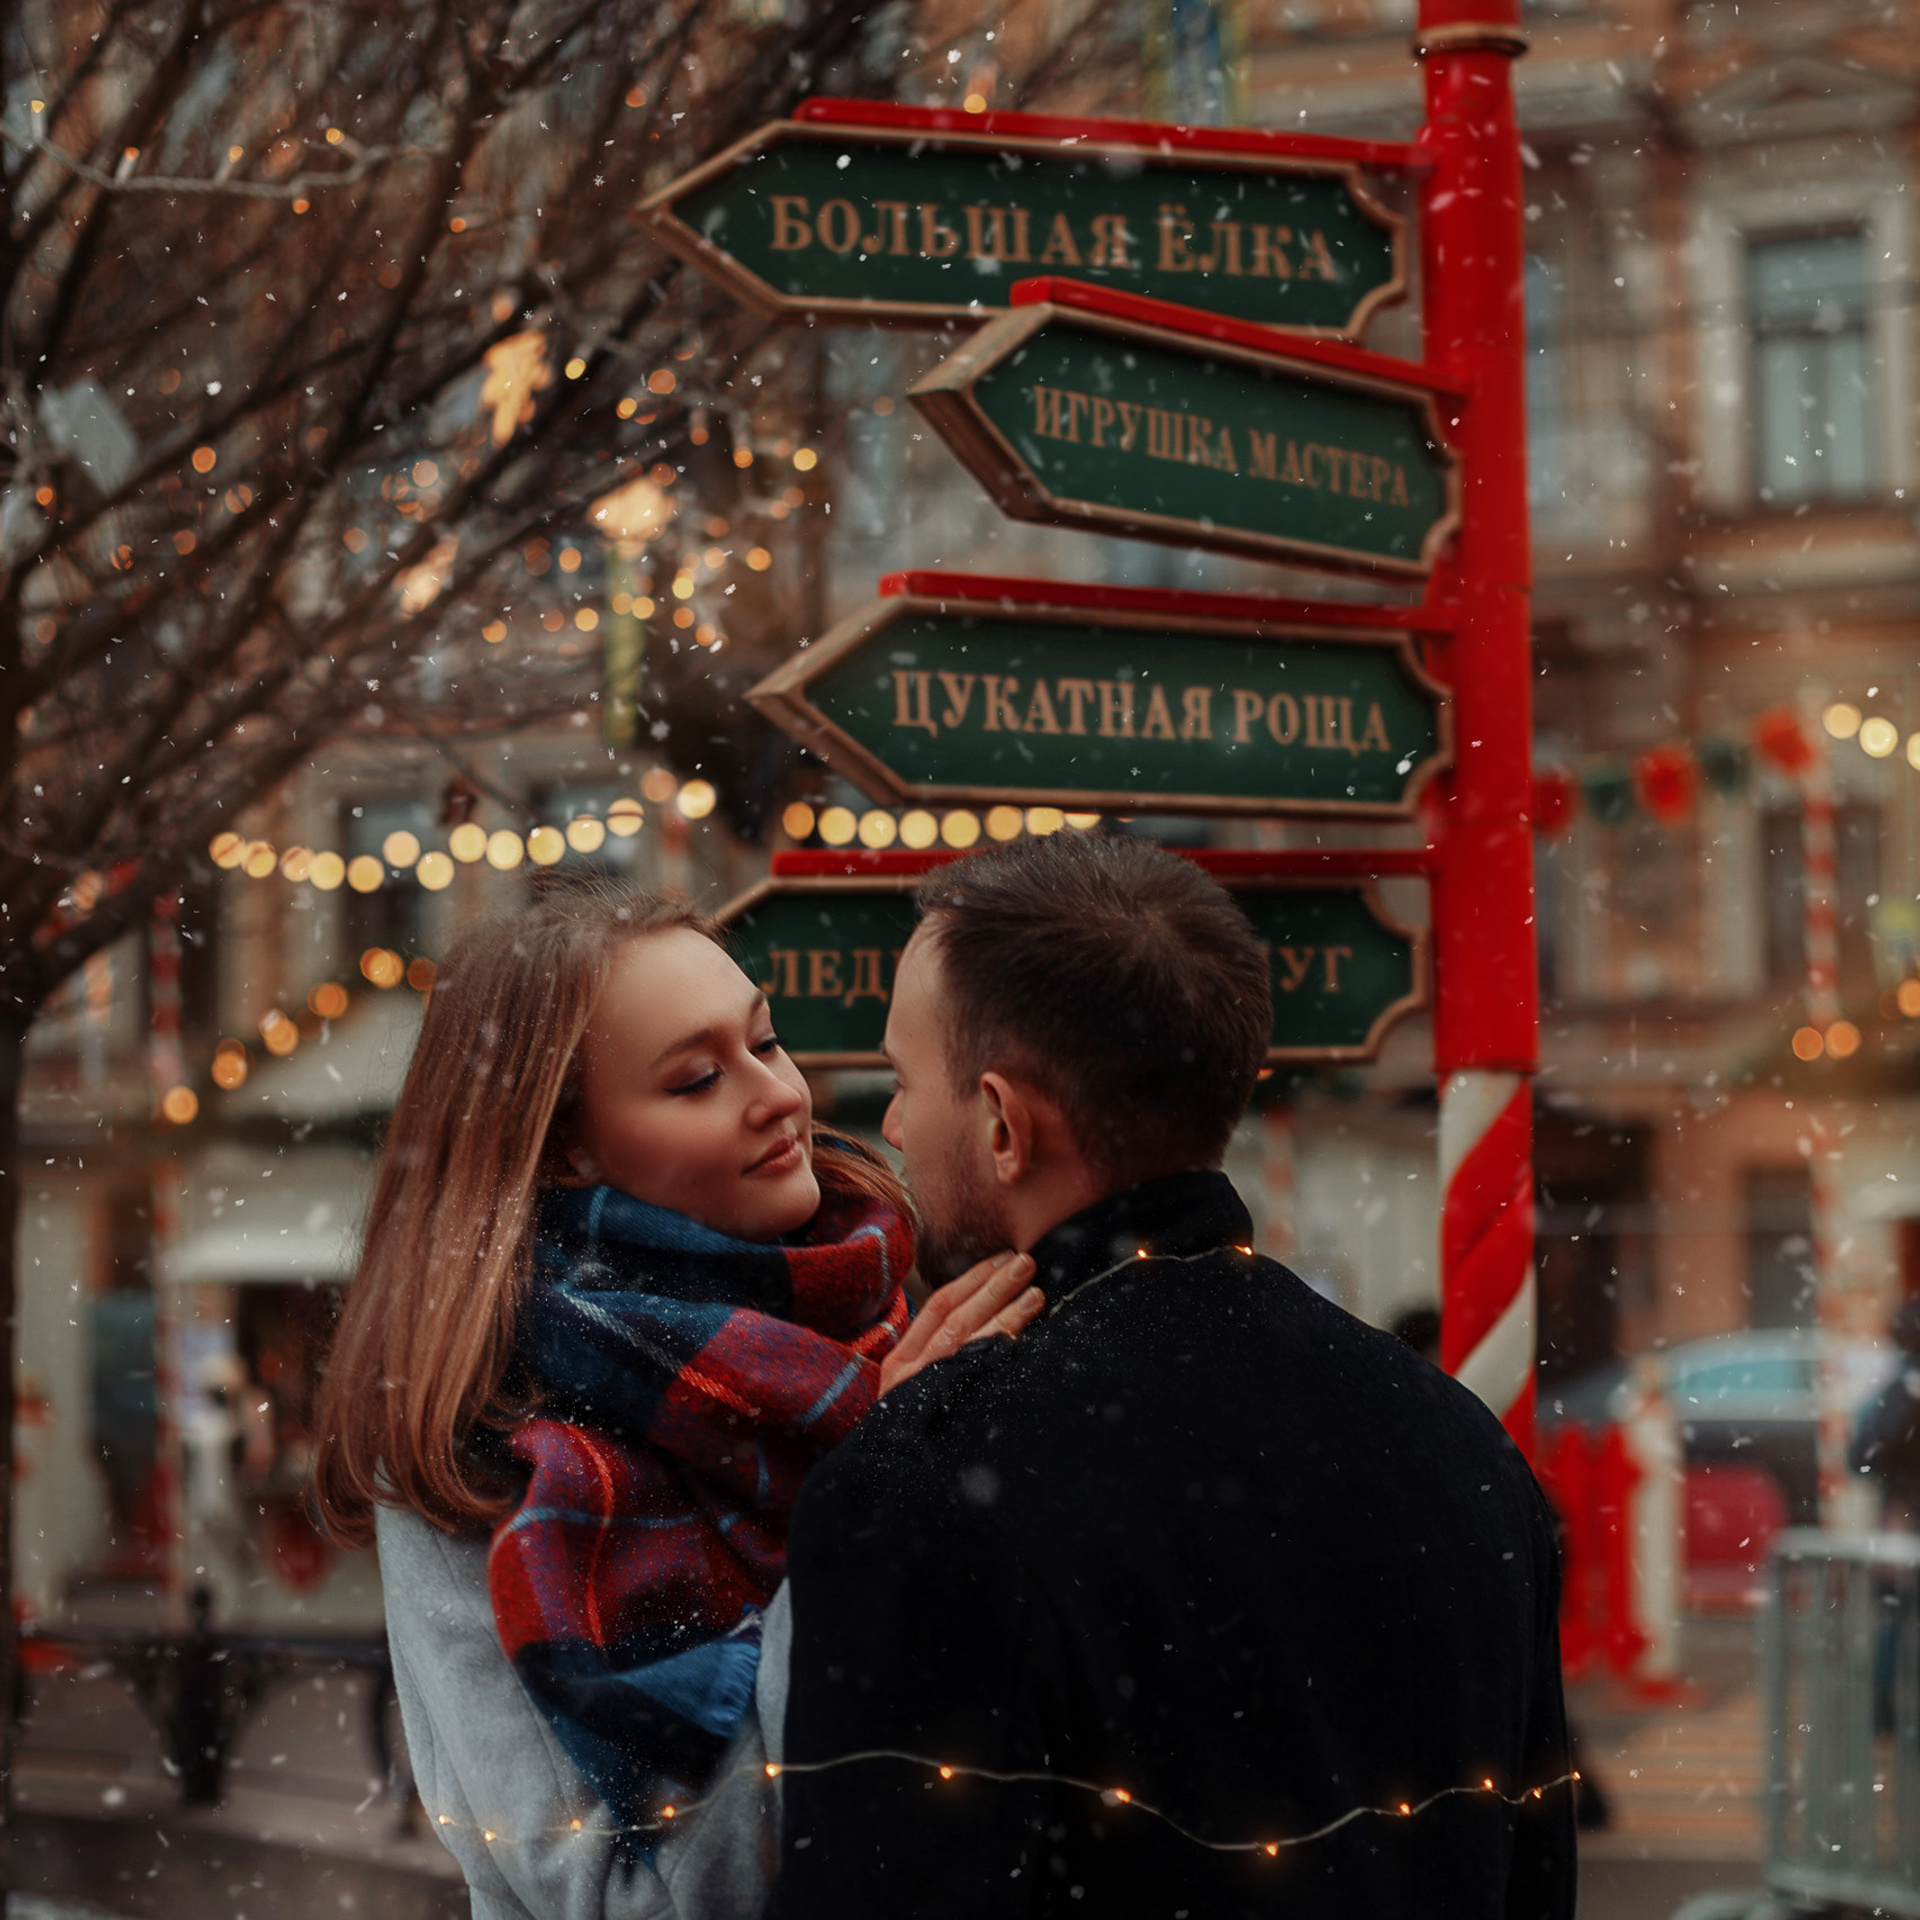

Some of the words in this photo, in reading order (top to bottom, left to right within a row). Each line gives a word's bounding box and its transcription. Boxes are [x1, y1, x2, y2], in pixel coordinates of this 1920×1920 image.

[769, 196, 1133, 268] БОЛЬШАЯ
[1156, 204, 1338, 281] ЁЛКА
[1032, 385, 1238, 473] ИГРУШКА
[1247, 428, 1410, 507] МАСТЕРА
[890, 669, 1214, 741] ЦУКАТНАЯ
[1232, 689, 1392, 757] РОЩА
[760, 948, 904, 1008] ЛЕД
[1262, 946, 1352, 992] УГ
